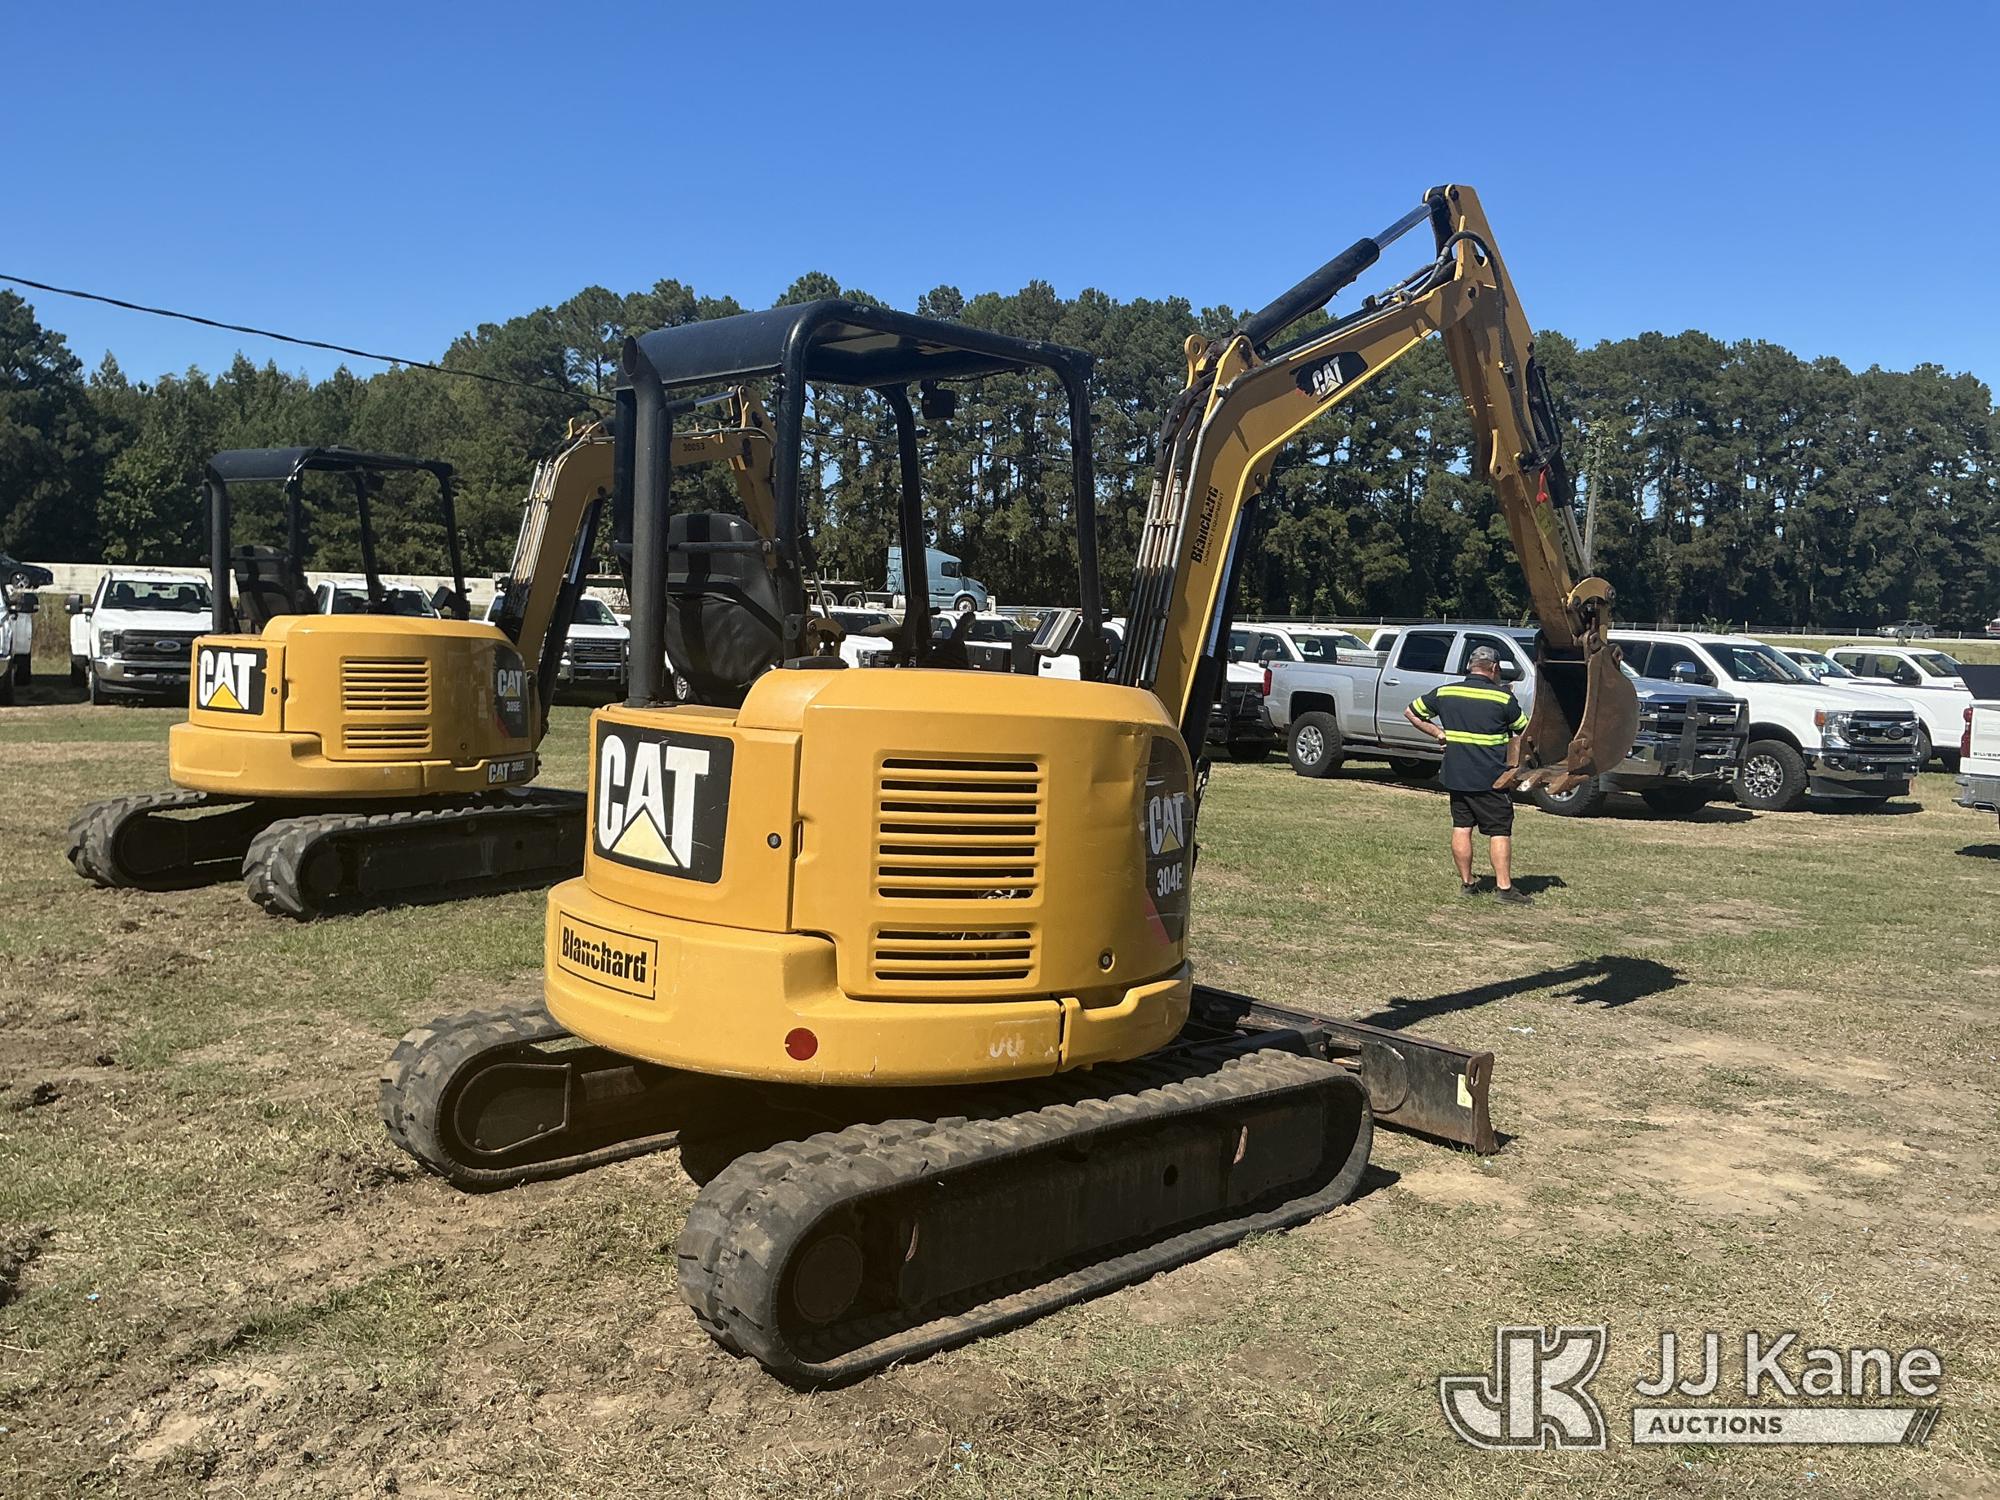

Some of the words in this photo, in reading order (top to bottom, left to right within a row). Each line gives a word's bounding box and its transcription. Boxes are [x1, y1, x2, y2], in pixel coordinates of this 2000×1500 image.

[1312, 356, 1343, 397] CAT
[199, 649, 257, 710] CAT
[497, 669, 523, 697] CAT
[488, 763, 510, 784] CAT
[598, 734, 711, 869] CAT
[1149, 792, 1184, 855] CAT
[1157, 862, 1183, 897] 304E
[562, 926, 647, 983] Blanchard
